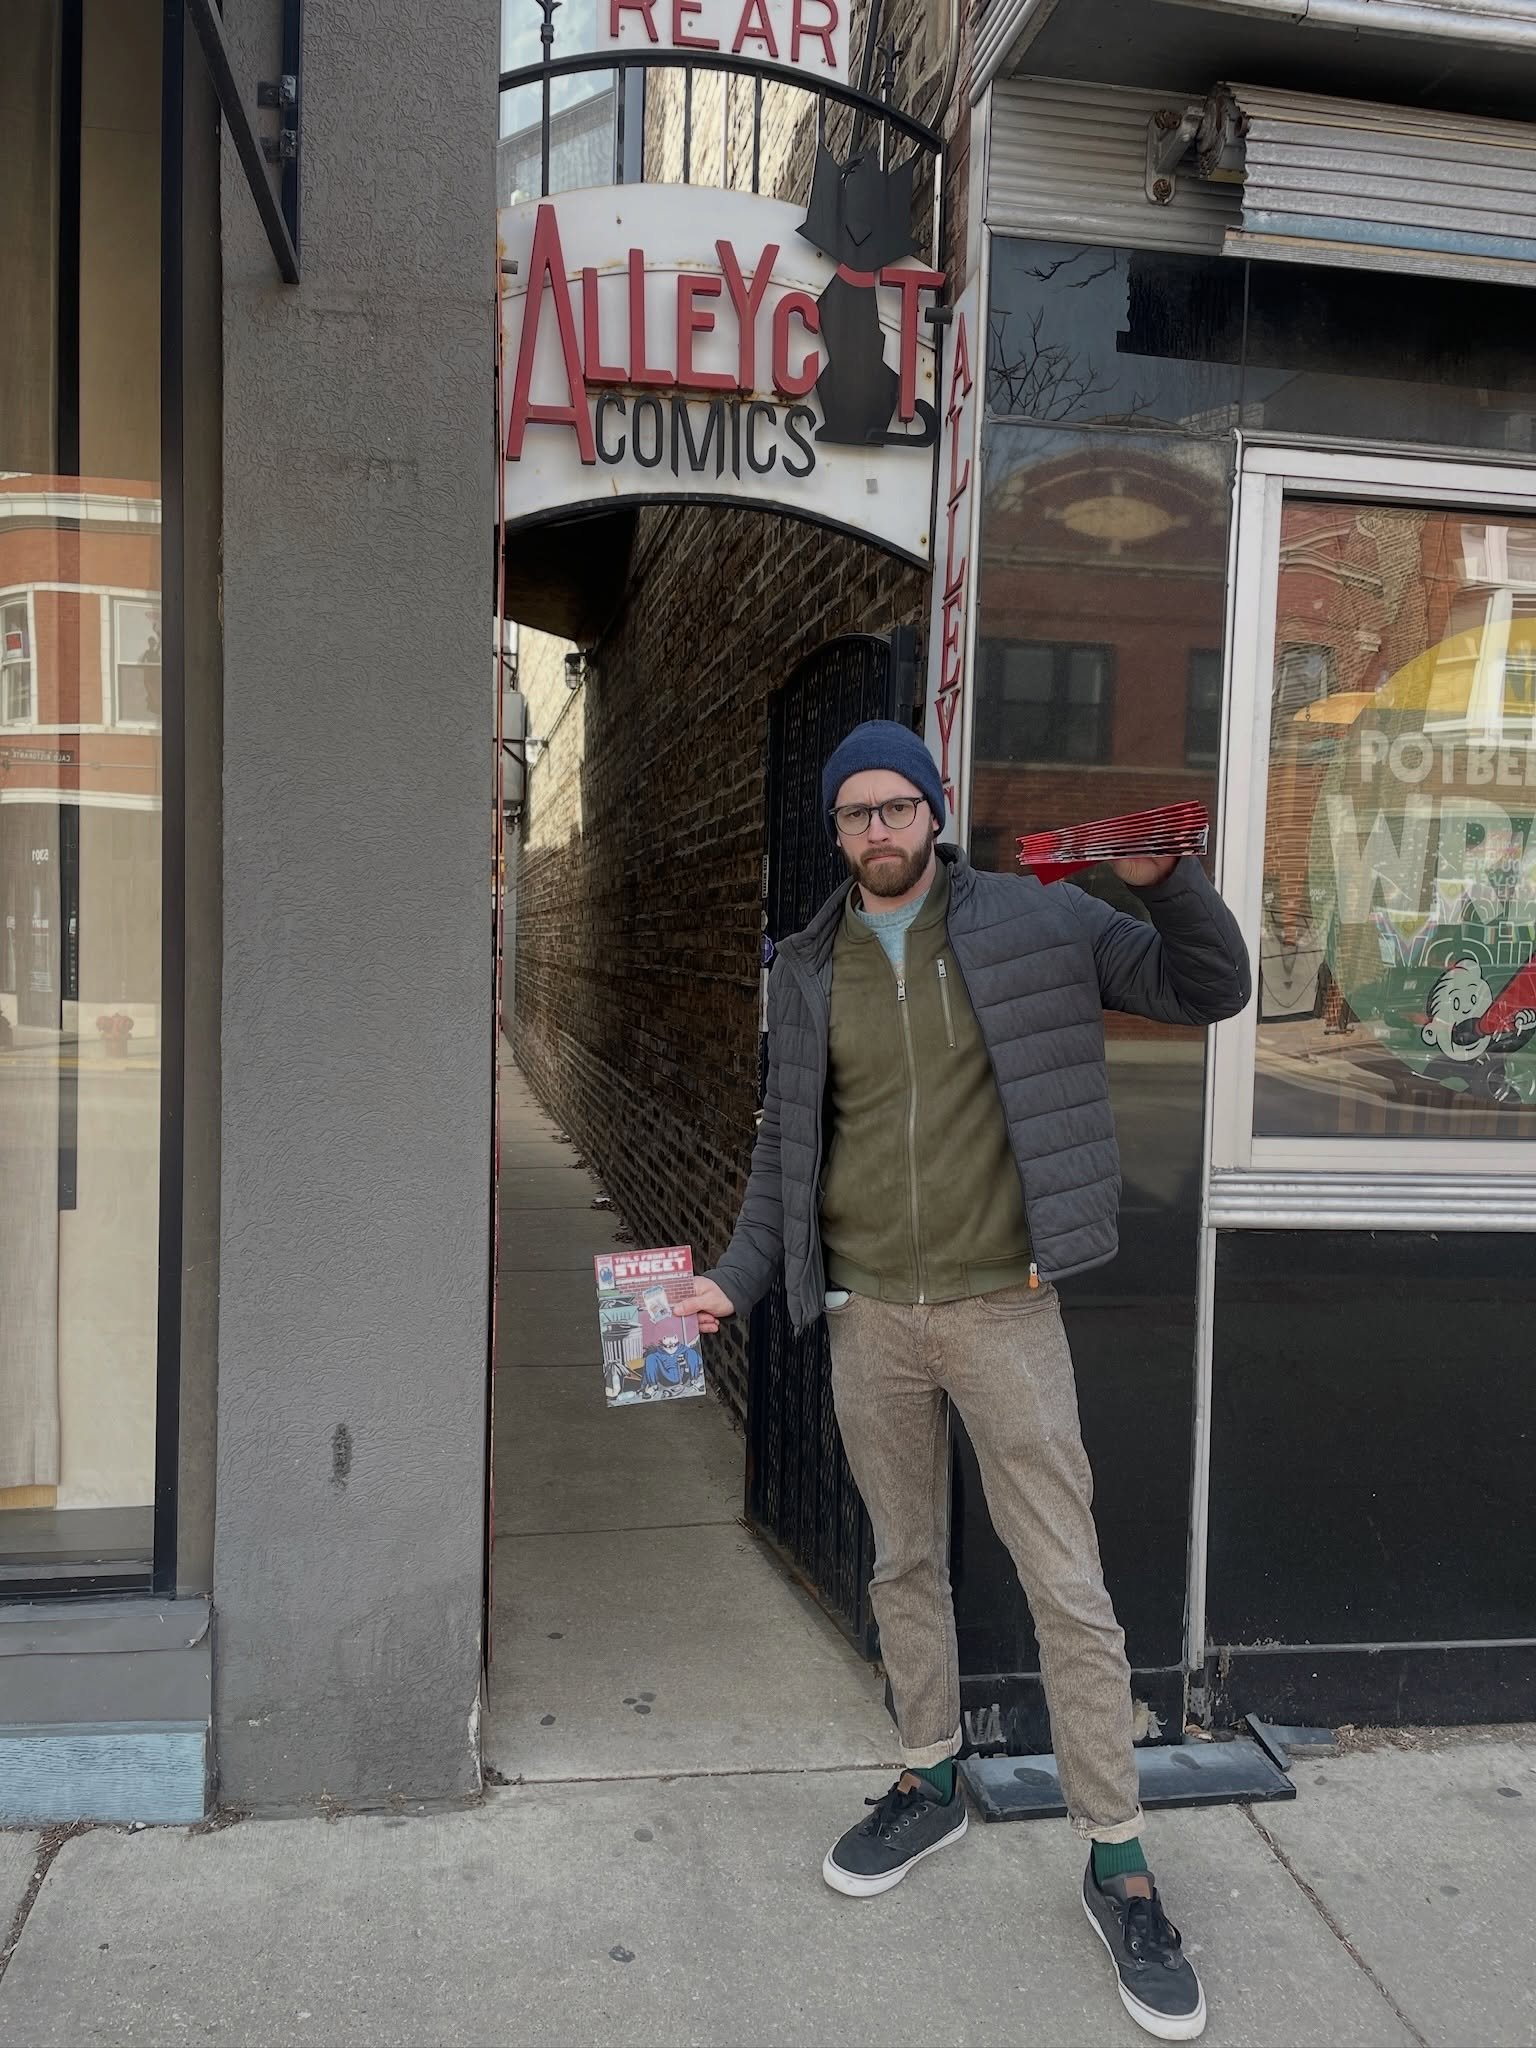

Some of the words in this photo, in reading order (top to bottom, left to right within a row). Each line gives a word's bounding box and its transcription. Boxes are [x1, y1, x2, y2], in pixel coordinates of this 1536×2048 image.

[609, 0, 838, 67] REAR
[506, 204, 946, 464] ALLEYCT
[595, 394, 817, 480] COMICS
[935, 311, 973, 814] ALLEY
[1326, 794, 1536, 924] WR
[615, 1257, 686, 1277] STREET
